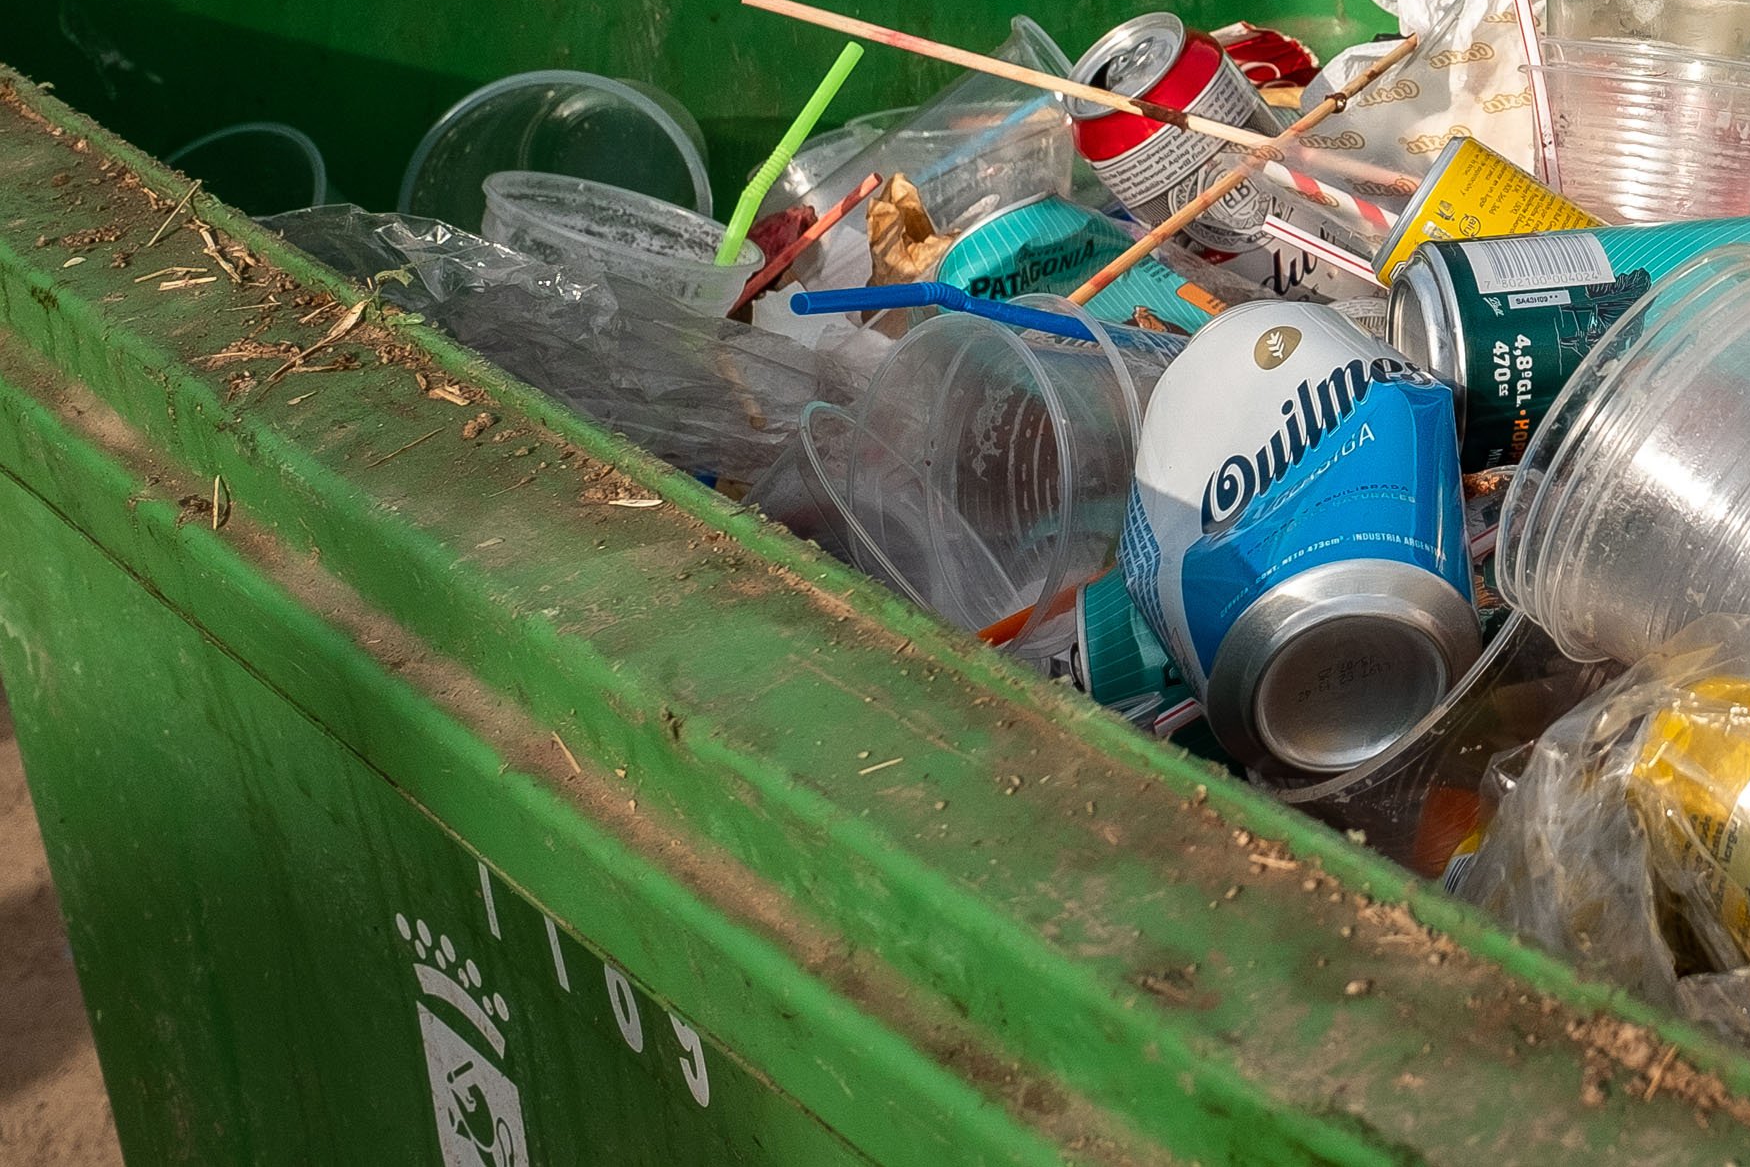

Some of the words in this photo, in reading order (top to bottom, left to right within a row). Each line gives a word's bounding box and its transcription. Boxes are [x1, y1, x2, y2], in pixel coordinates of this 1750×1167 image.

[1134, 137, 1175, 166] Budweiser
[1176, 157, 1194, 173] will
[1461, 217, 1478, 236] alu
[964, 239, 1096, 300] PATAGONIA
[1484, 280, 1492, 290] 7
[1501, 275, 1548, 289] 802100
[1552, 272, 1599, 284] 004024
[1201, 357, 1438, 535] Quilmes
[1281, 550, 1306, 569] NETO
[1352, 533, 1401, 544] INDUSTRIA
